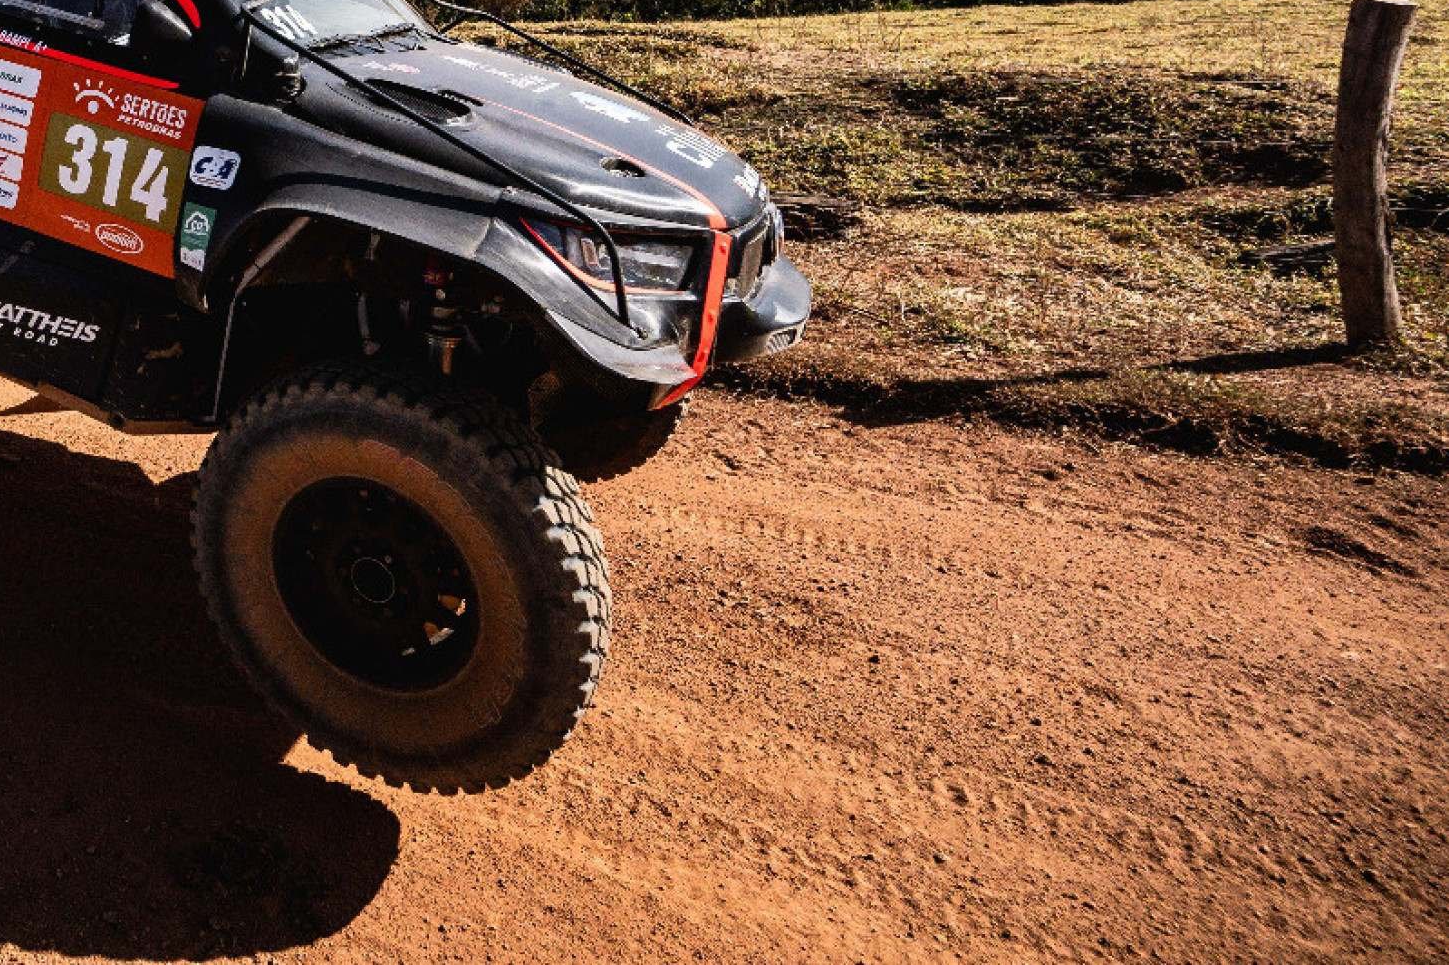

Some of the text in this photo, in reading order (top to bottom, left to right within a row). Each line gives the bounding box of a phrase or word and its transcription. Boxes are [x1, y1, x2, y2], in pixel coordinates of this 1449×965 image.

[260, 4, 318, 41] 314
[116, 114, 182, 140] PETROBRAS
[120, 93, 187, 130] SERTÕES
[58, 123, 169, 224] 314
[13, 326, 58, 347] ROAD
